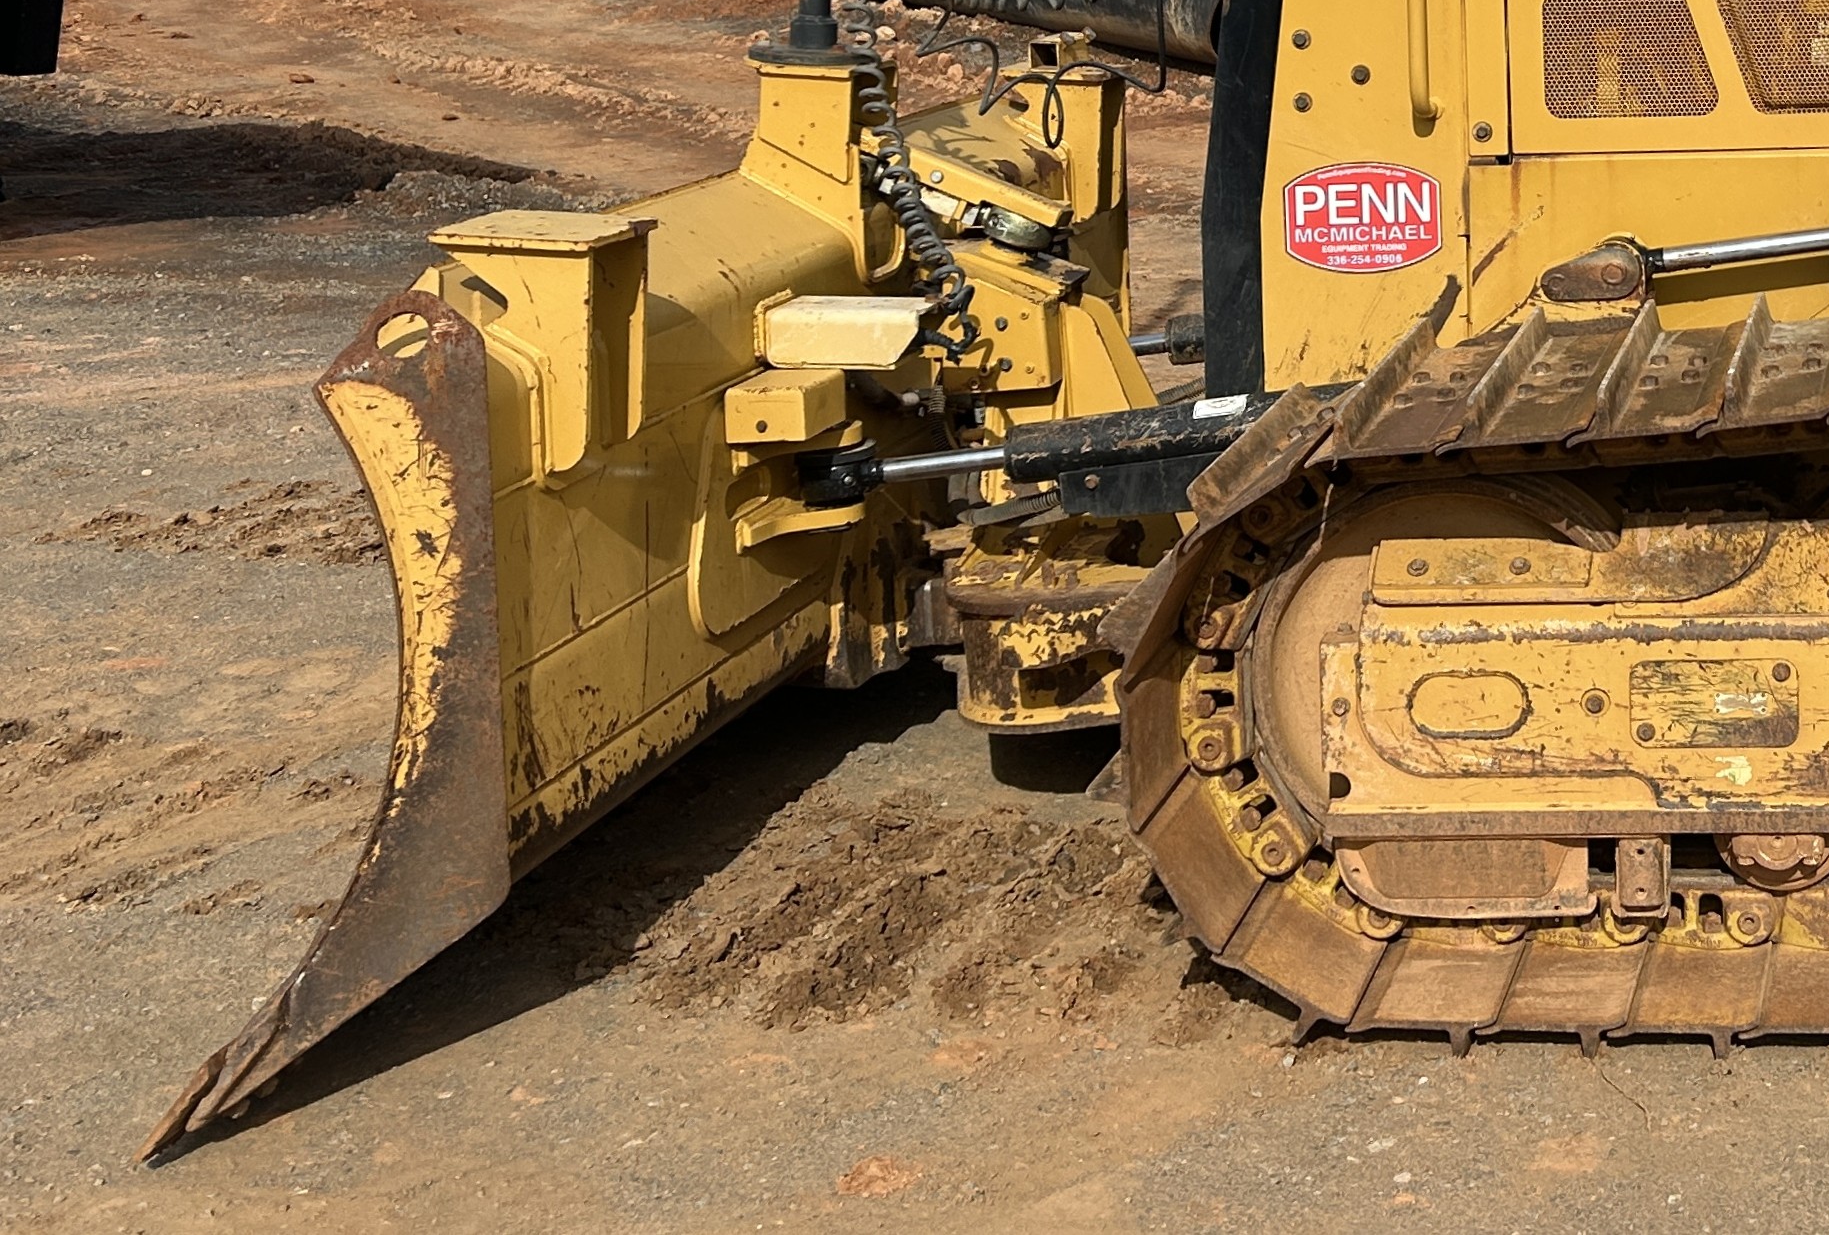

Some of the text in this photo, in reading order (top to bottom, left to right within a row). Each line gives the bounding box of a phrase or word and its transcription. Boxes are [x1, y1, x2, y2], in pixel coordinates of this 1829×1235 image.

[1294, 181, 1431, 226] PENN
[1295, 225, 1432, 243] MCMICHAEL
[1321, 243, 1407, 253] EQUIPMENT TRADING
